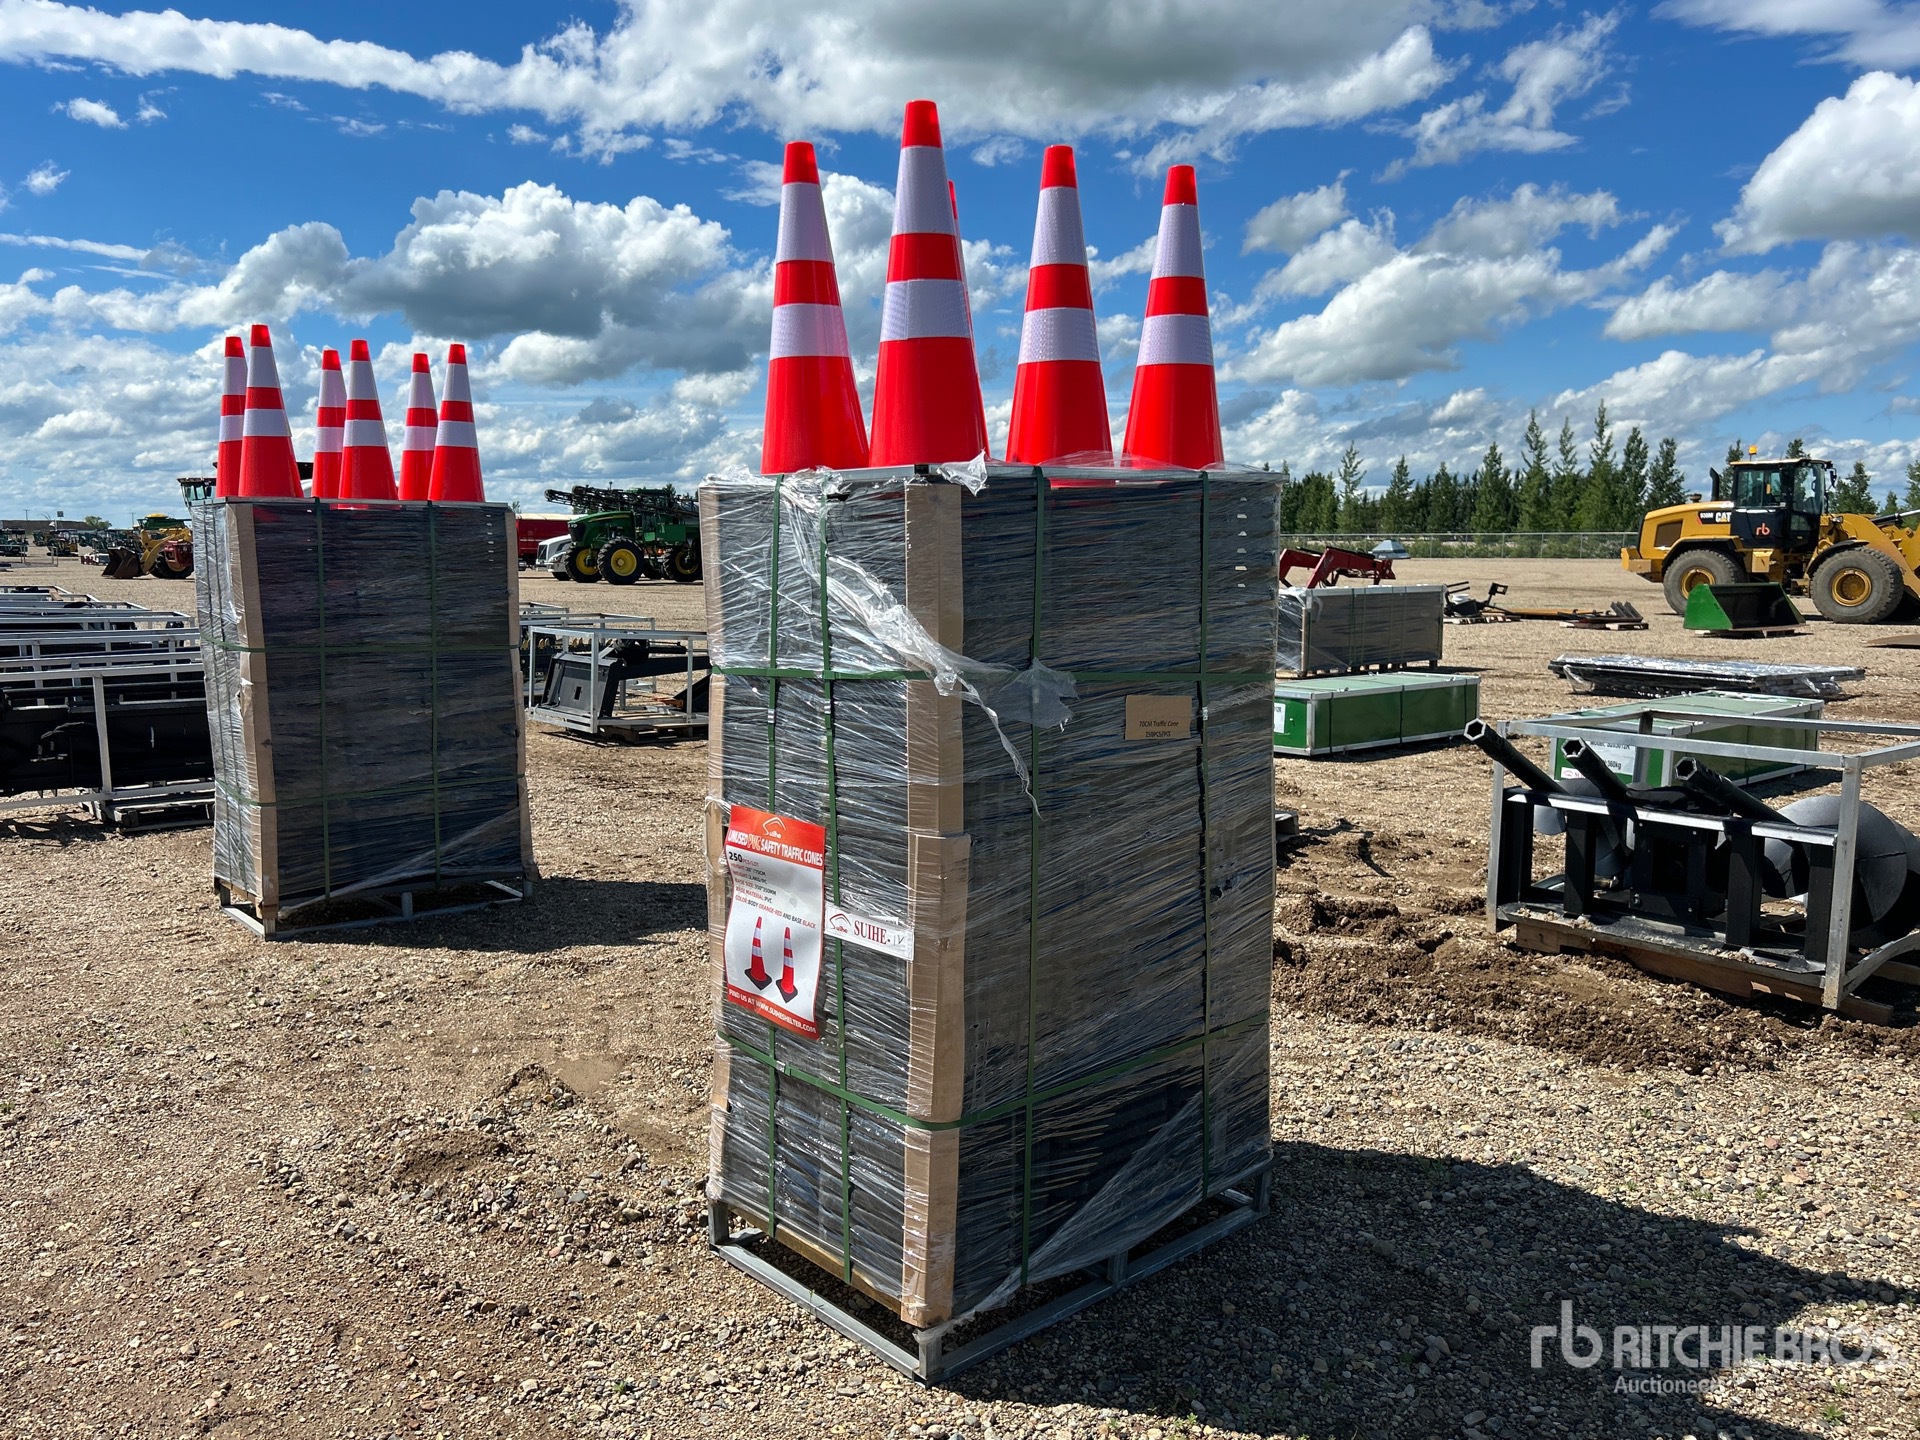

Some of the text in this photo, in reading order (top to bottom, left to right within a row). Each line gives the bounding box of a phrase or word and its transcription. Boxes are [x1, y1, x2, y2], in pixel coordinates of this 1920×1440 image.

[1715, 511, 1732, 523] CAT
[1755, 522, 1771, 536] rb
[727, 829, 823, 867] UNUSED PVC SAFETY TRAFFIC CONES
[736, 886, 746, 894] BASE
[782, 911, 792, 921] AND
[791, 915, 802, 925] BASE
[801, 918, 816, 929] BLACK
[728, 989, 741, 999] FIND
[740, 994, 748, 1002] US
[748, 997, 755, 1005] AT
